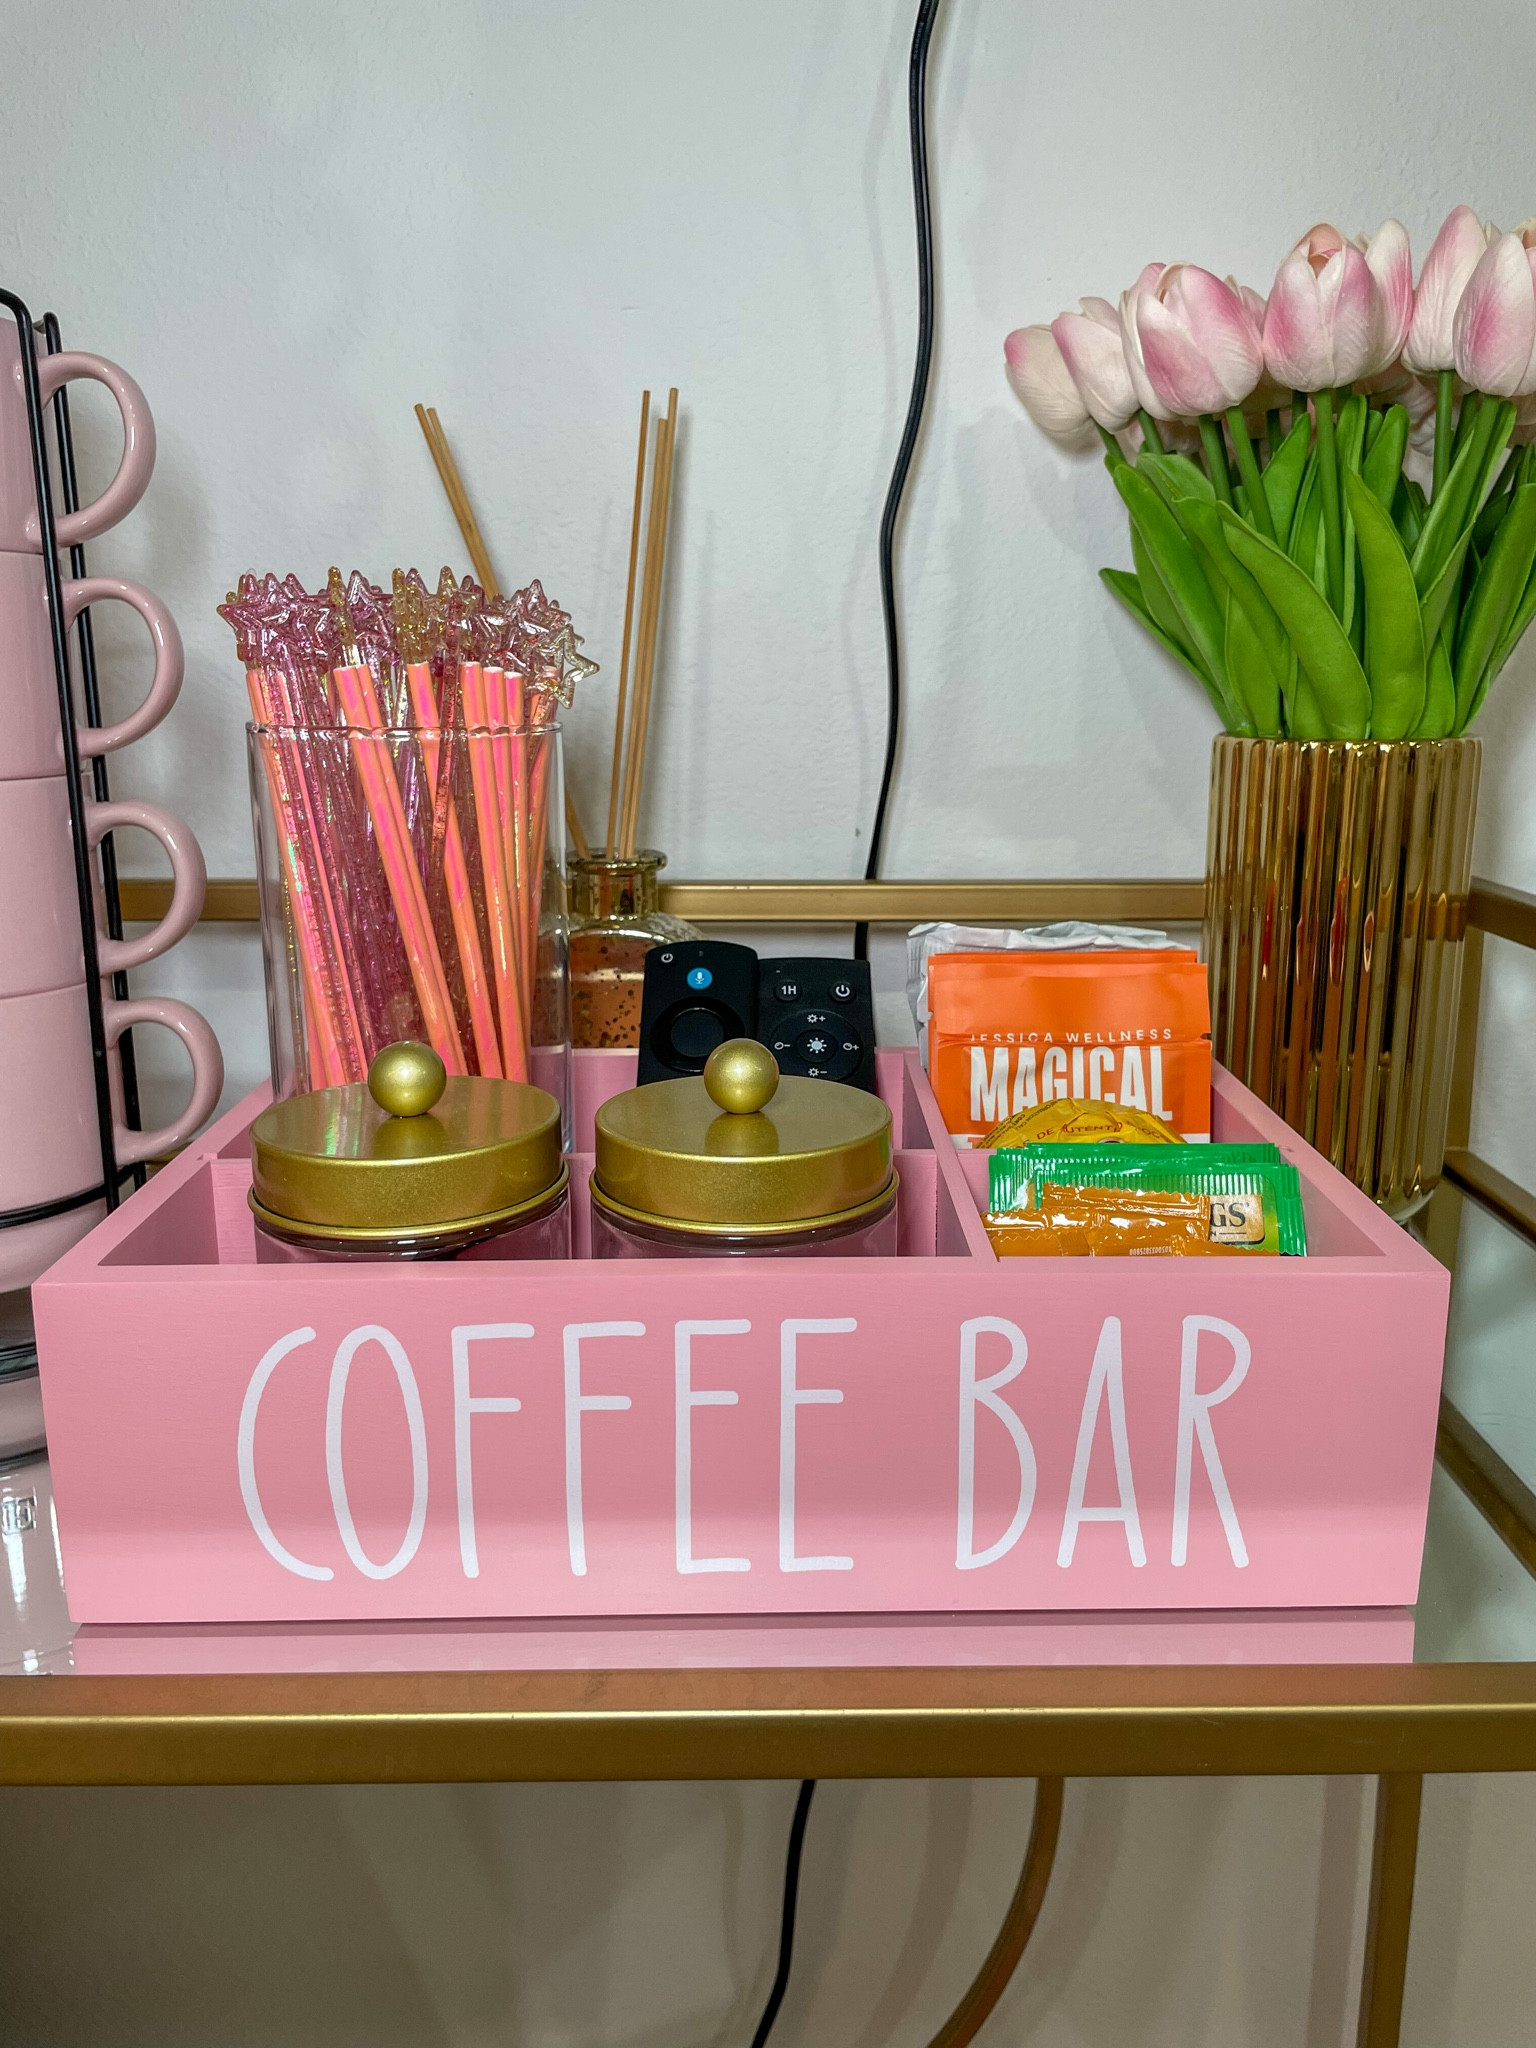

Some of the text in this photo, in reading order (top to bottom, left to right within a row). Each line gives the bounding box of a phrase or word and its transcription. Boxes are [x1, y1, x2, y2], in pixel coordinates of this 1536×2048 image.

[781, 985, 797, 995] 1H
[970, 1028, 1172, 1043] JESSICA WELLNESS
[970, 1046, 1173, 1122] MAGICAL
[236, 1314, 1252, 1582] COFFEE BAR
